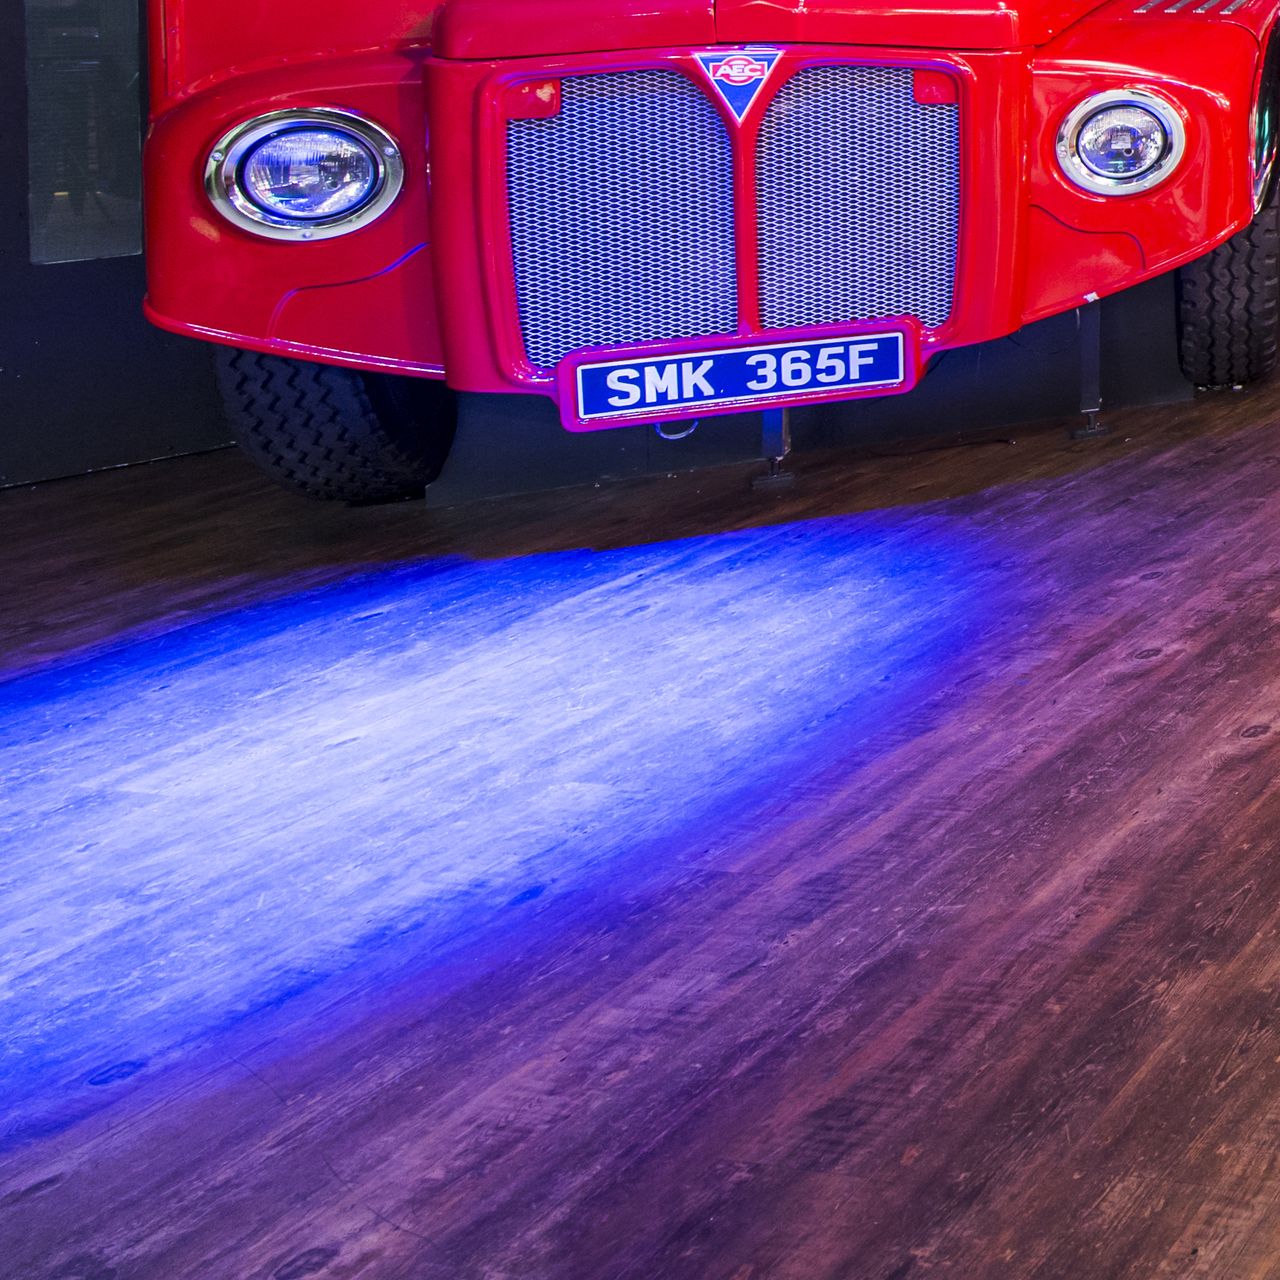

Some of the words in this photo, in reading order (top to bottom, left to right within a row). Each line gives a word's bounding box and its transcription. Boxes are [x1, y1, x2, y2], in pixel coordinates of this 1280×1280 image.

[714, 64, 763, 77] AEC
[606, 359, 717, 408] SMK
[745, 342, 879, 391] 365F
